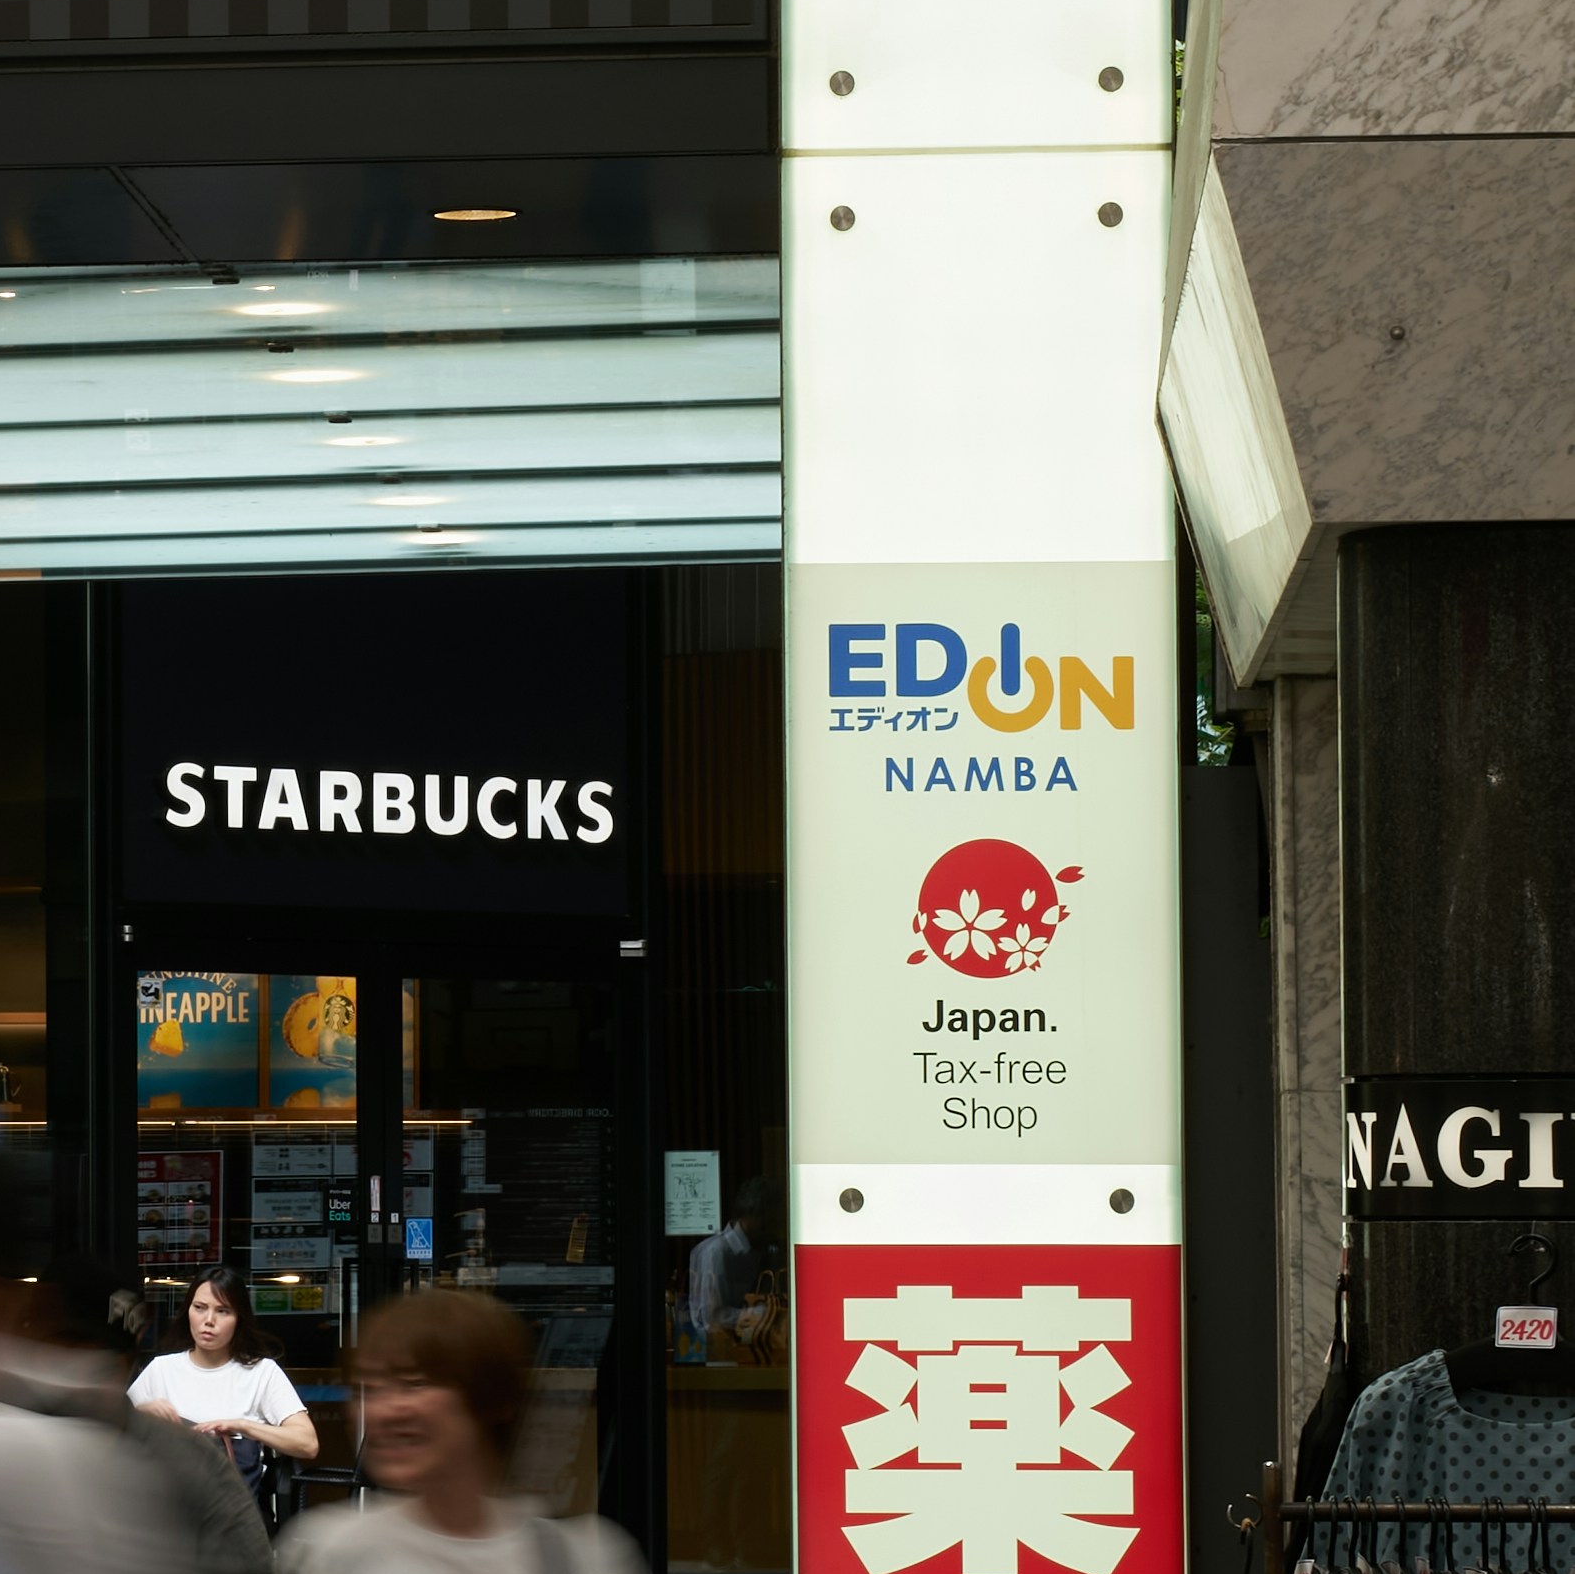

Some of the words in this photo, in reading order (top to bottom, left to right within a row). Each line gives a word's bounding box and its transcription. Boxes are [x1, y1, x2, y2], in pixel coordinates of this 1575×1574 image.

[829, 706, 959, 732] エディオン
[885, 756, 1078, 792] NAMBA
[166, 762, 613, 843] STARBUCKS
[922, 1000, 1058, 1040] Japan.
[913, 1052, 1067, 1085] Tax-free
[942, 1097, 1038, 1137] Shop
[1347, 1102, 1575, 1190] NAGI
[329, 1199, 351, 1210] Uber
[329, 1210, 351, 1221] Eats
